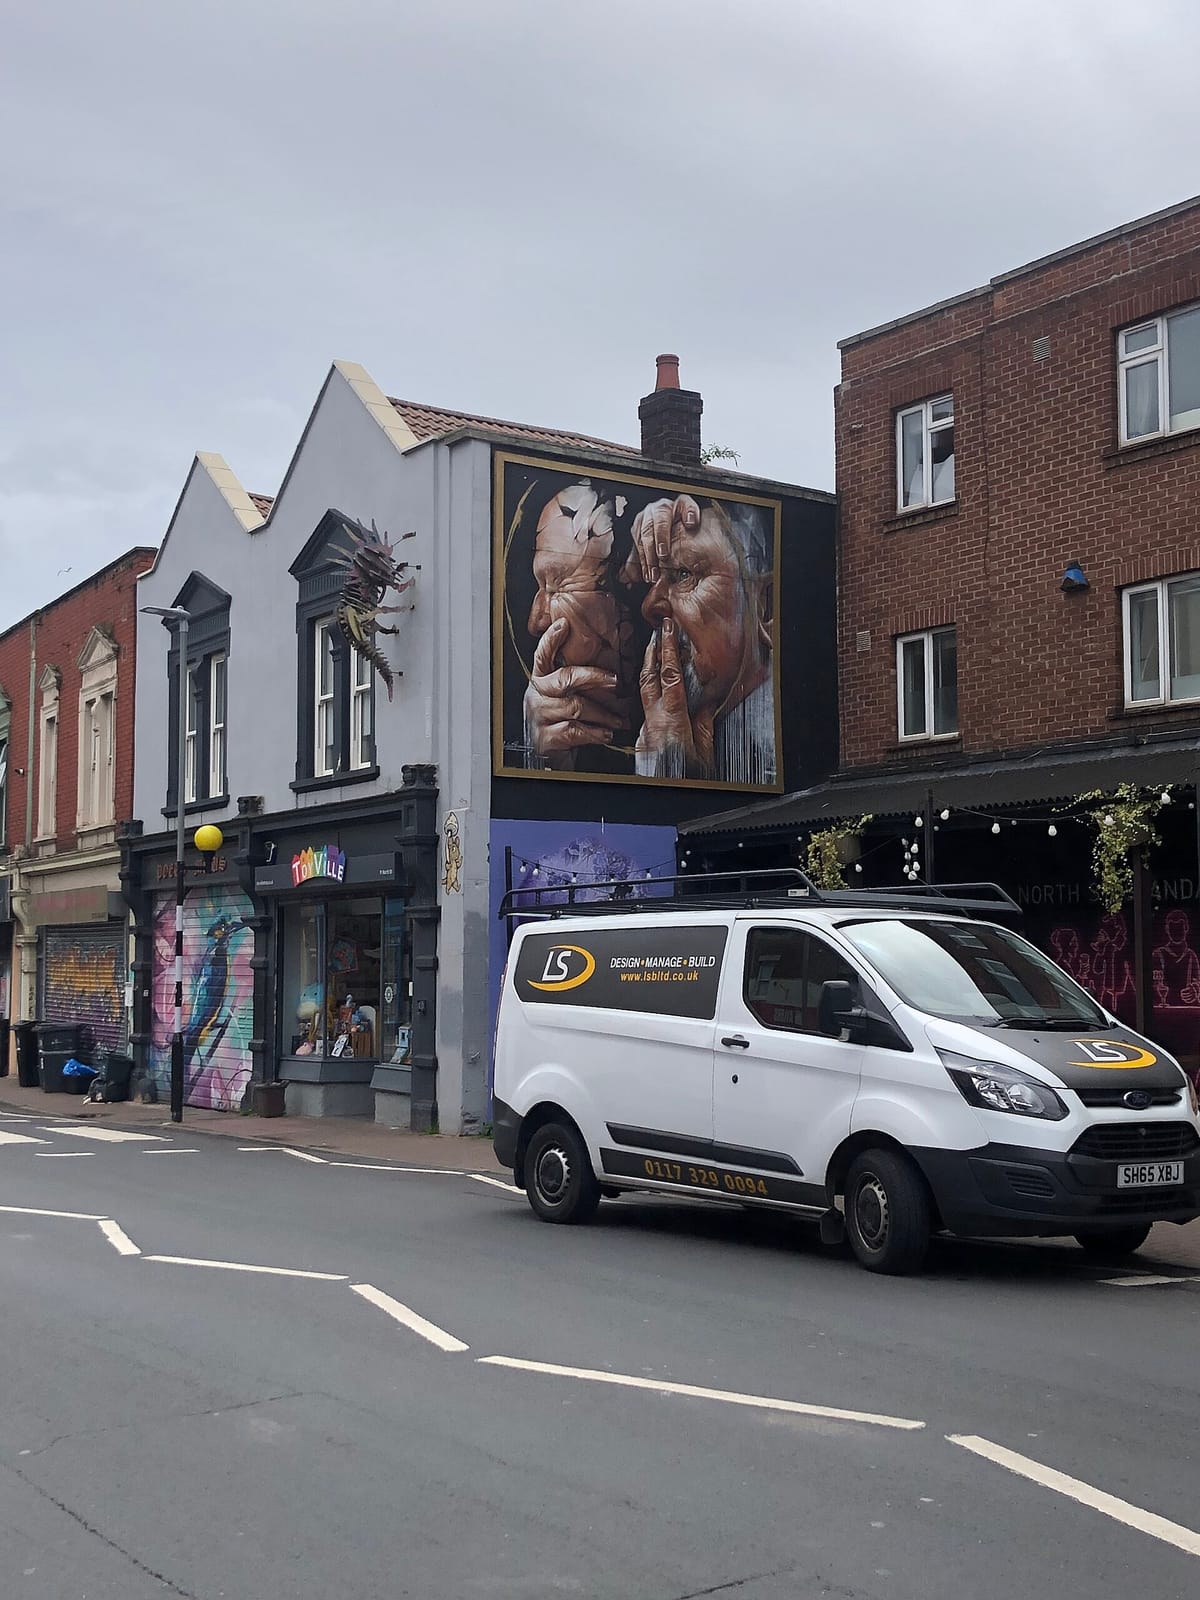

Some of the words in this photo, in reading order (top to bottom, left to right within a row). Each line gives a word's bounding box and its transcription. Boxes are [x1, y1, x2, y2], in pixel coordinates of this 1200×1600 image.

[1018, 883, 1080, 905] NORTH
[542, 950, 572, 982] LS
[610, 957, 640, 969] DESIGN
[645, 956, 682, 968] MANAGE
[688, 956, 716, 967] BUILD
[620, 970, 699, 982] www.lsbltd.co.uk
[1074, 1041, 1128, 1062] LS
[645, 1159, 681, 1180] 0117
[688, 1167, 719, 1186] 329
[724, 1174, 769, 1195] 0094
[1123, 1166, 1155, 1184] SH65
[1157, 1165, 1180, 1182] XBJ
